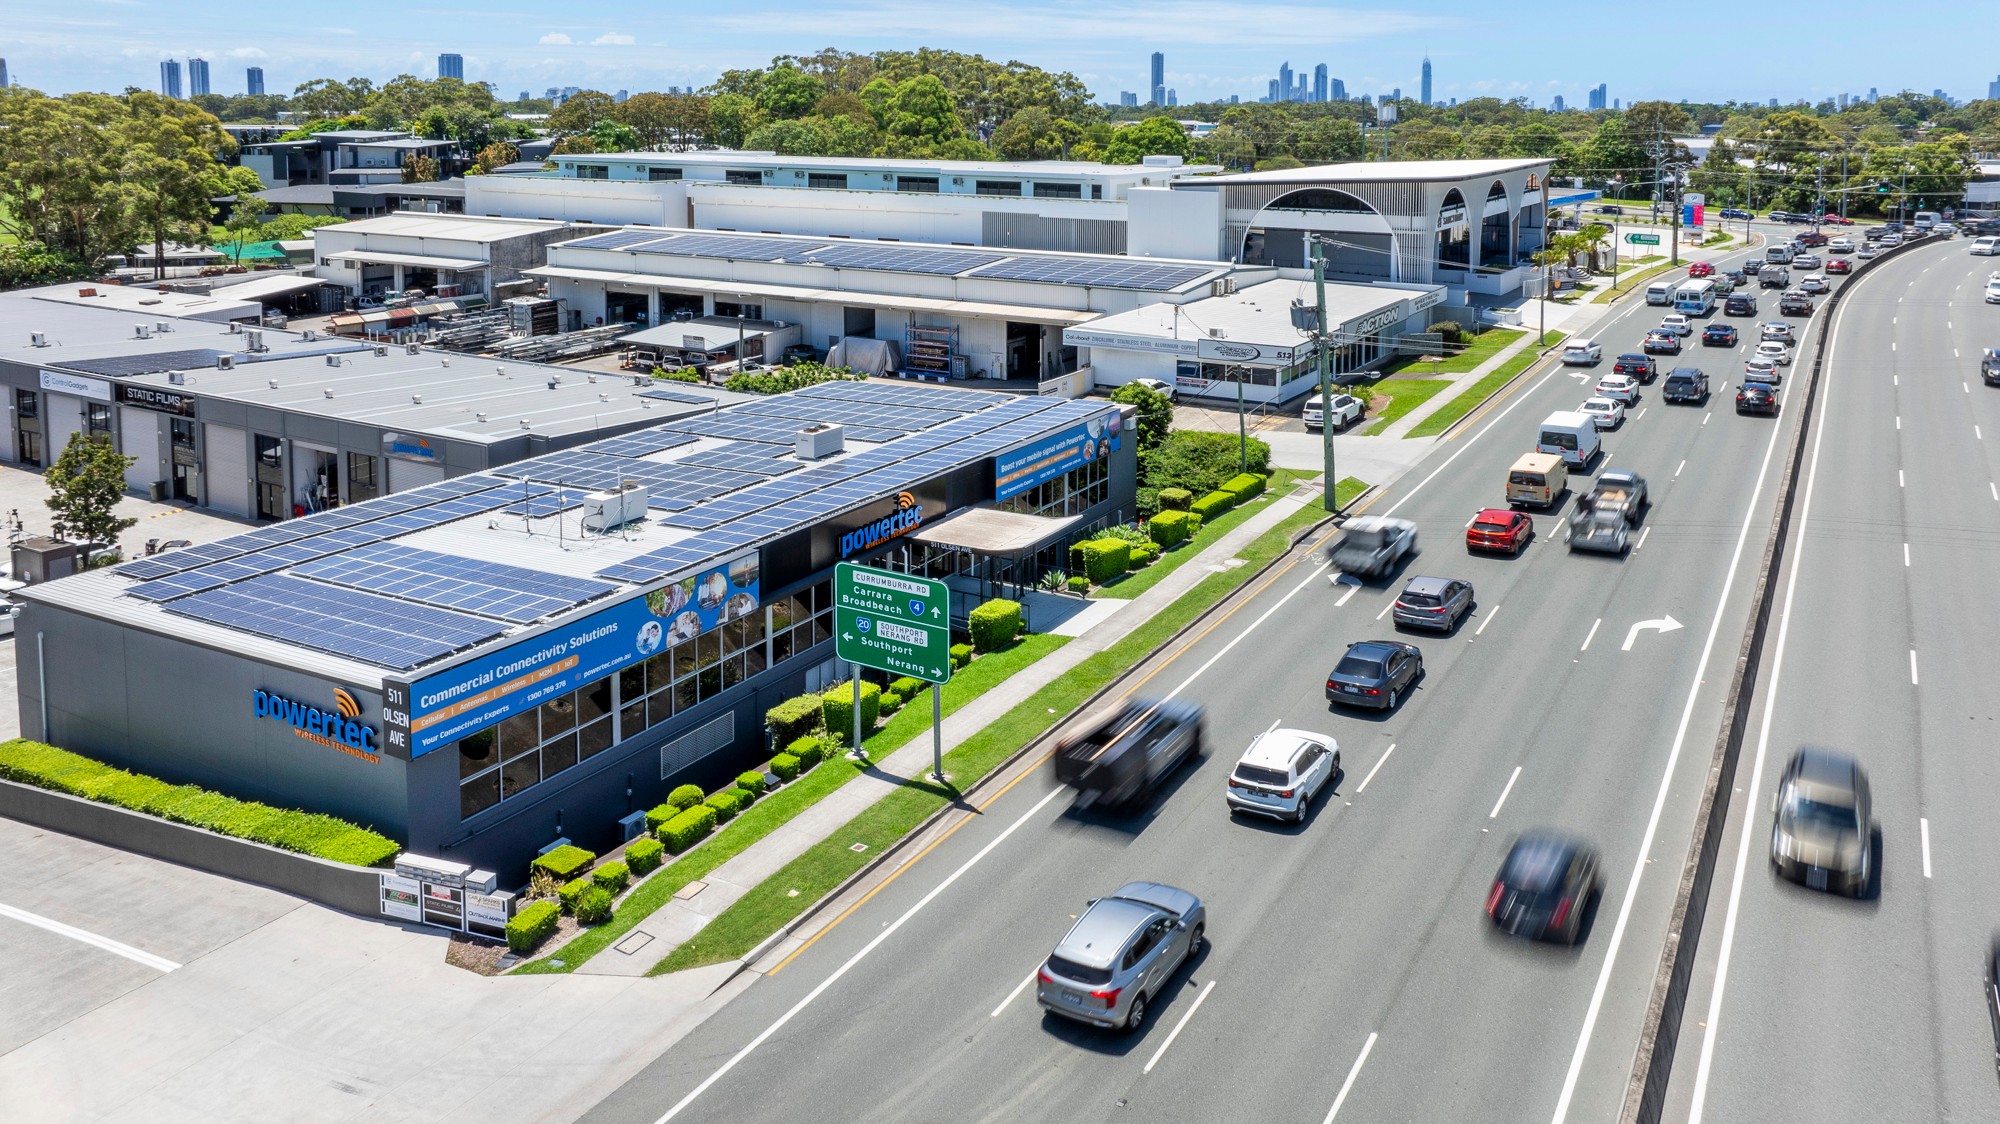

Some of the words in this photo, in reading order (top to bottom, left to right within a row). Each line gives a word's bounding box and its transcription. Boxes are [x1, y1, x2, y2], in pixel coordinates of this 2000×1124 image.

[1415, 292, 1440, 306] SHEETMETAL
[1420, 298, 1438, 310] ROOFING
[1358, 305, 1399, 335] ACTION
[1117, 338, 1138, 346] STAINLESS
[1155, 342, 1178, 350] ALUMINIUM
[52, 378, 88, 391] ControlGadgets
[127, 387, 154, 402] STATIC
[156, 392, 181, 406] FILMS
[1001, 459, 1015, 473] Boost
[1015, 456, 1026, 468] your
[1026, 450, 1042, 463] mobile
[1042, 444, 1056, 457] signal
[1066, 434, 1086, 446] Powertec
[842, 505, 923, 559] powertec
[865, 535, 890, 550] WIRELESS
[940, 543, 960, 552] OLSEN
[960, 546, 972, 554] AVE
[856, 574, 912, 591] CURRUMBURRA
[916, 586, 926, 594] RD
[854, 586, 892, 601] Carrara
[842, 594, 902, 614] Broadbeach
[914, 603, 920, 612] 4
[858, 620, 869, 628] 20
[880, 622, 923, 636] SOUTHPORT
[880, 629, 911, 642] NERANG
[914, 636, 924, 644] RD
[861, 636, 912, 656] Southport
[420, 667, 493, 709] Commercial
[496, 641, 568, 678] Connectivity
[570, 622, 618, 649] Solutions
[583, 652, 632, 678] powertec.com.au
[886, 656, 924, 674] Nerang
[388, 688, 402, 704] 511
[420, 711, 446, 727] Cellular
[459, 694, 488, 710] Antennas
[501, 678, 526, 694] Wireless
[538, 668, 553, 678] M2M
[564, 659, 574, 668] IoT
[527, 690, 542, 702] 1300
[542, 685, 555, 697] 769
[556, 680, 567, 692] 378
[253, 688, 376, 753] powertec
[384, 708, 409, 728] OLSEN
[422, 733, 438, 747] Your
[439, 715, 484, 739] Connectivity
[484, 704, 510, 721] Experts
[294, 728, 330, 748] WIRELESS
[332, 740, 380, 765] TECHNOLOGY
[390, 730, 404, 747] AVE
[468, 910, 488, 920] OUTBACK
